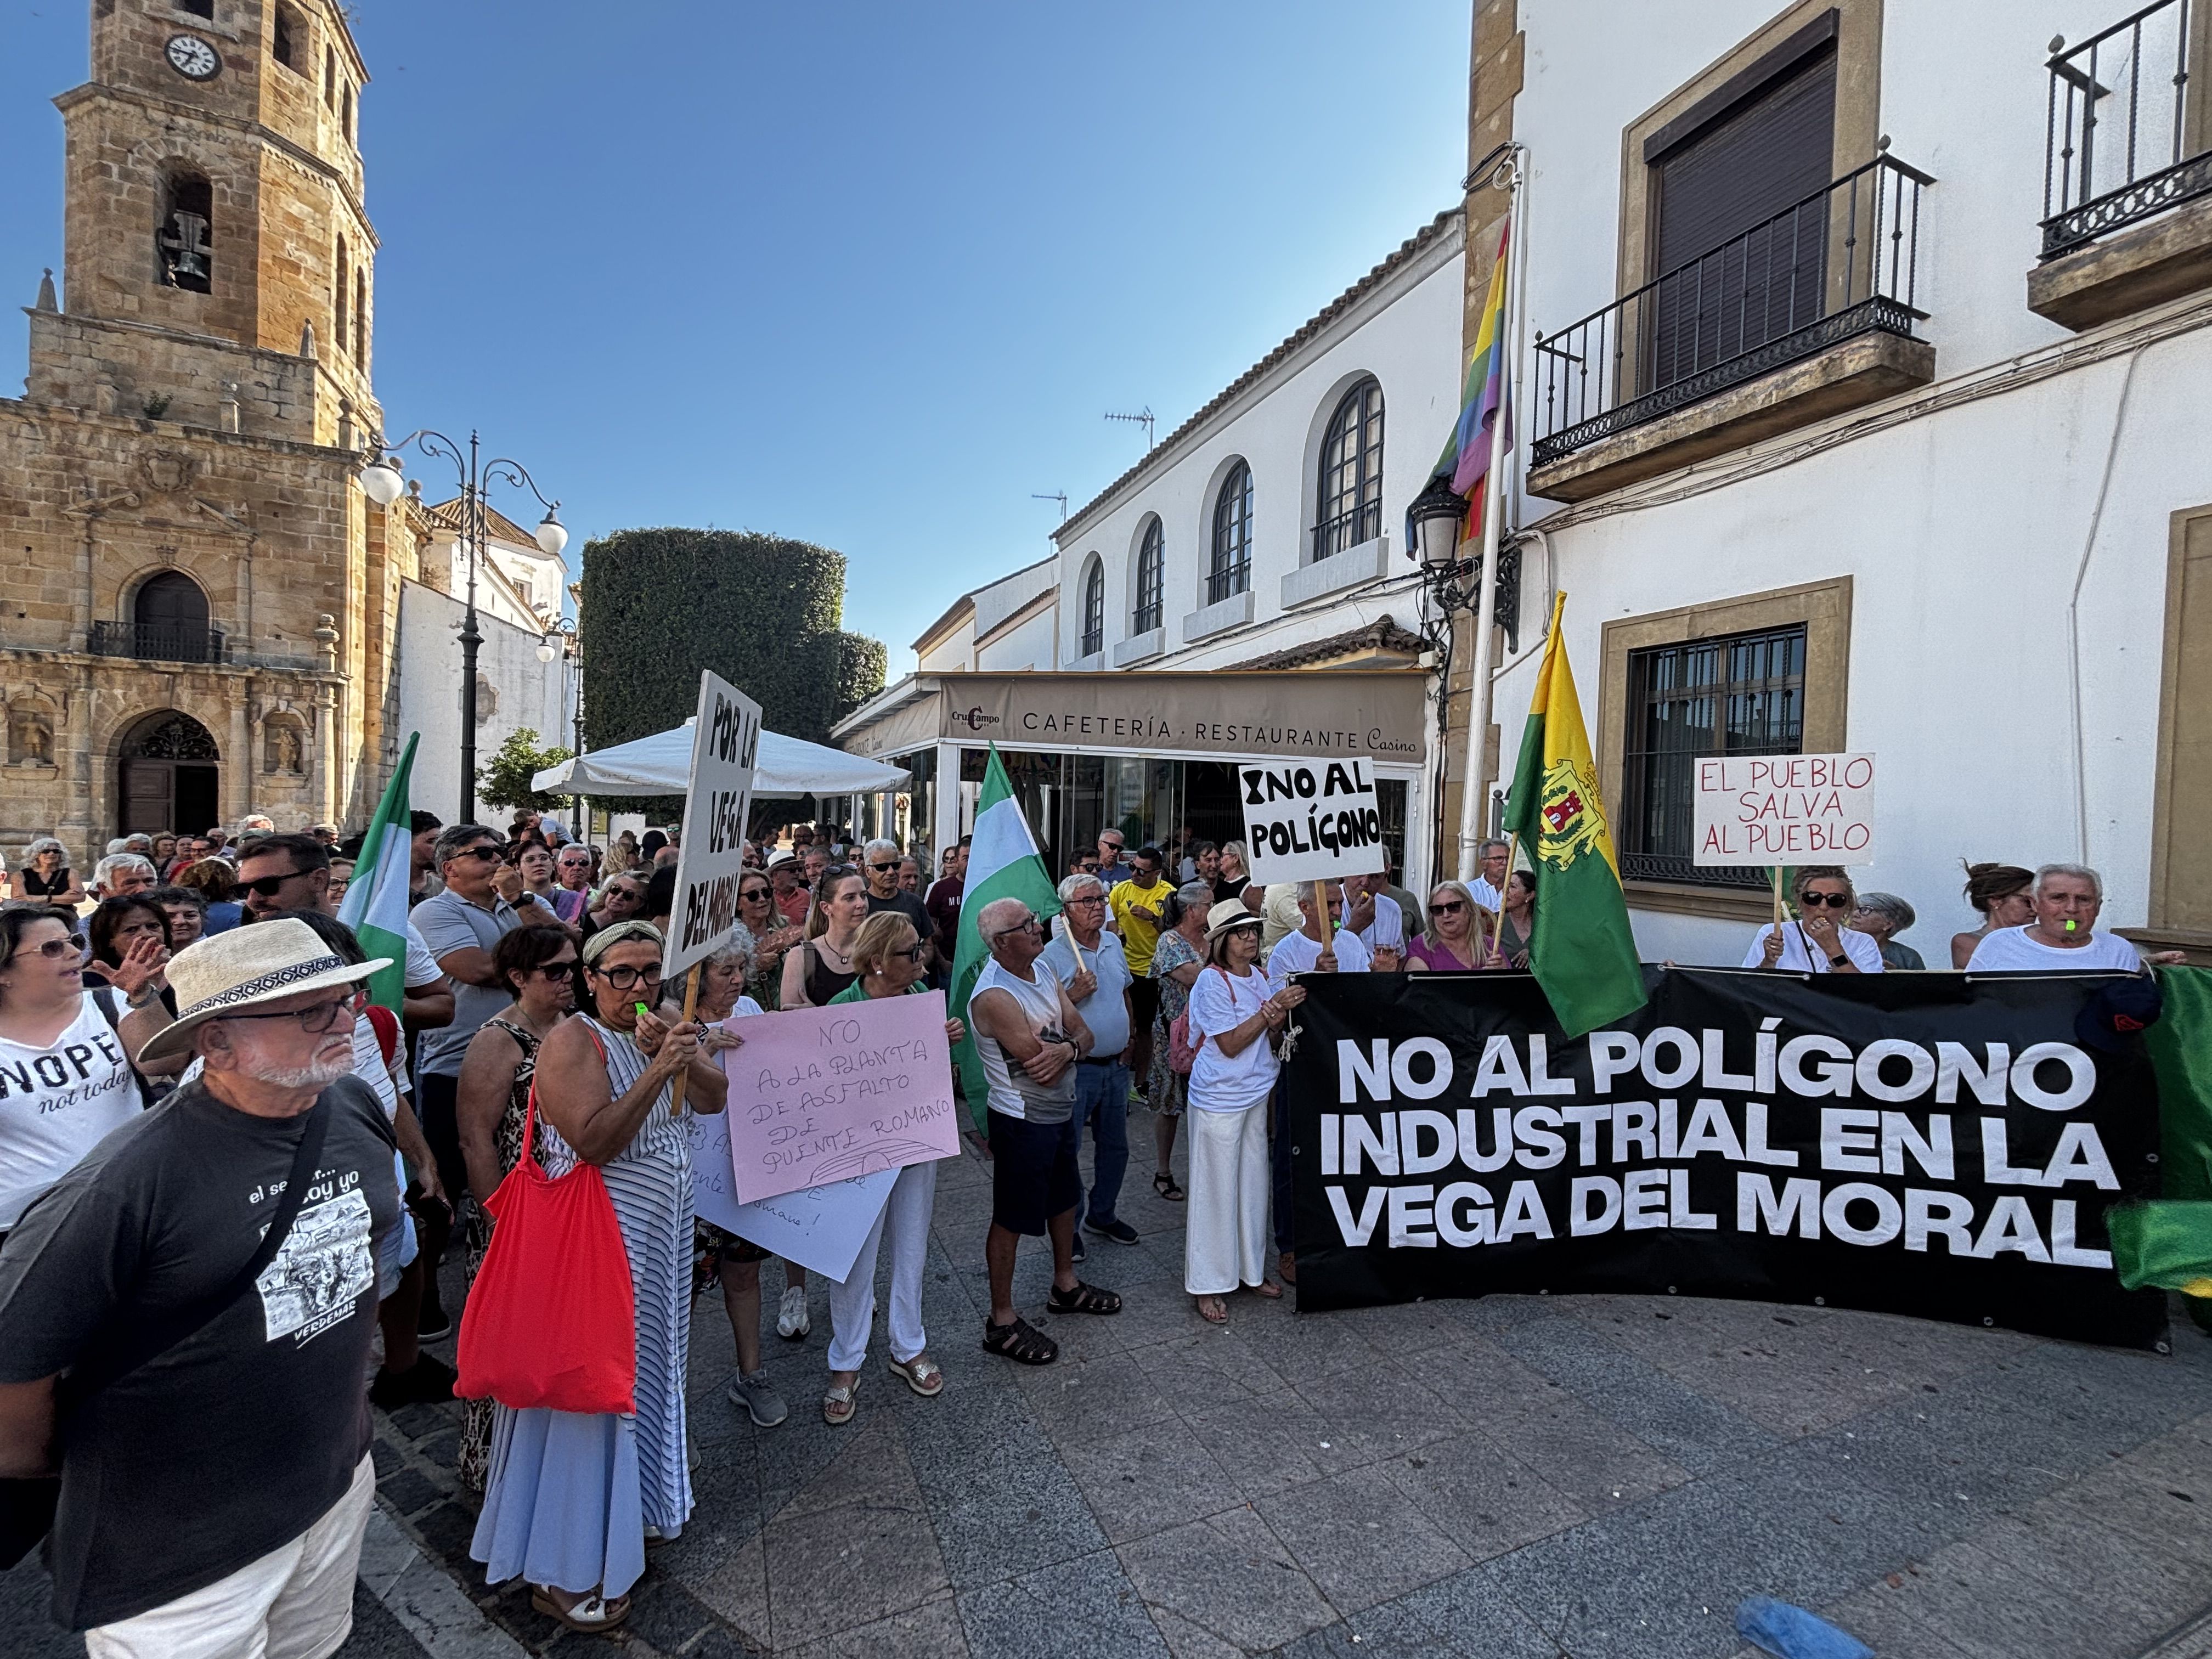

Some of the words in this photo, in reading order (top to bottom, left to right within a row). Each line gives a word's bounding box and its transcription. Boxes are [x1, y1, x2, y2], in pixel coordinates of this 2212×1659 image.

[709, 692, 740, 763] POR
[741, 711, 757, 771] LA
[1023, 713, 1170, 737] CAFETERÍA
[1195, 723, 1357, 748] RESTAURANTE
[1367, 728, 1417, 752] Casino
[1324, 761, 1373, 797] AL
[1702, 763, 1736, 791] EL
[1750, 758, 1872, 789] PUEBLO
[710, 791, 744, 853] VEGA
[1738, 791, 1843, 822] SALVA
[1251, 803, 1380, 858] POLÍGONO
[1702, 823, 1738, 854] AL
[1745, 822, 1870, 853] PUEBLO
[820, 1020, 860, 1046] NO
[0, 1031, 123, 1099] NOPE
[757, 1069, 780, 1093] A
[830, 1040, 928, 1074] PLANTA
[1337, 1037, 1453, 1103] NO
[1470, 1034, 1576, 1097] AL
[1589, 1018, 2096, 1110] POLÍGONO
[38, 1090, 78, 1114] not
[83, 1068, 132, 1101] today
[747, 1101, 789, 1124] DE
[799, 1075, 909, 1112] ASFALTO
[768, 1118, 820, 1145] DE
[870, 1100, 949, 1136] ROMANO
[1321, 1099, 1798, 1175] INDUSTRIAL
[1820, 1108, 1955, 1180] EN
[1980, 1117, 2121, 1190] LA
[249, 1185, 264, 1204] el
[338, 1171, 359, 1193] yo
[1325, 1180, 1554, 1248] VEGA
[1570, 1169, 1717, 1237] DEL
[1737, 1171, 2113, 1268] MORAL
[294, 1300, 356, 1341] VERDEMAR
